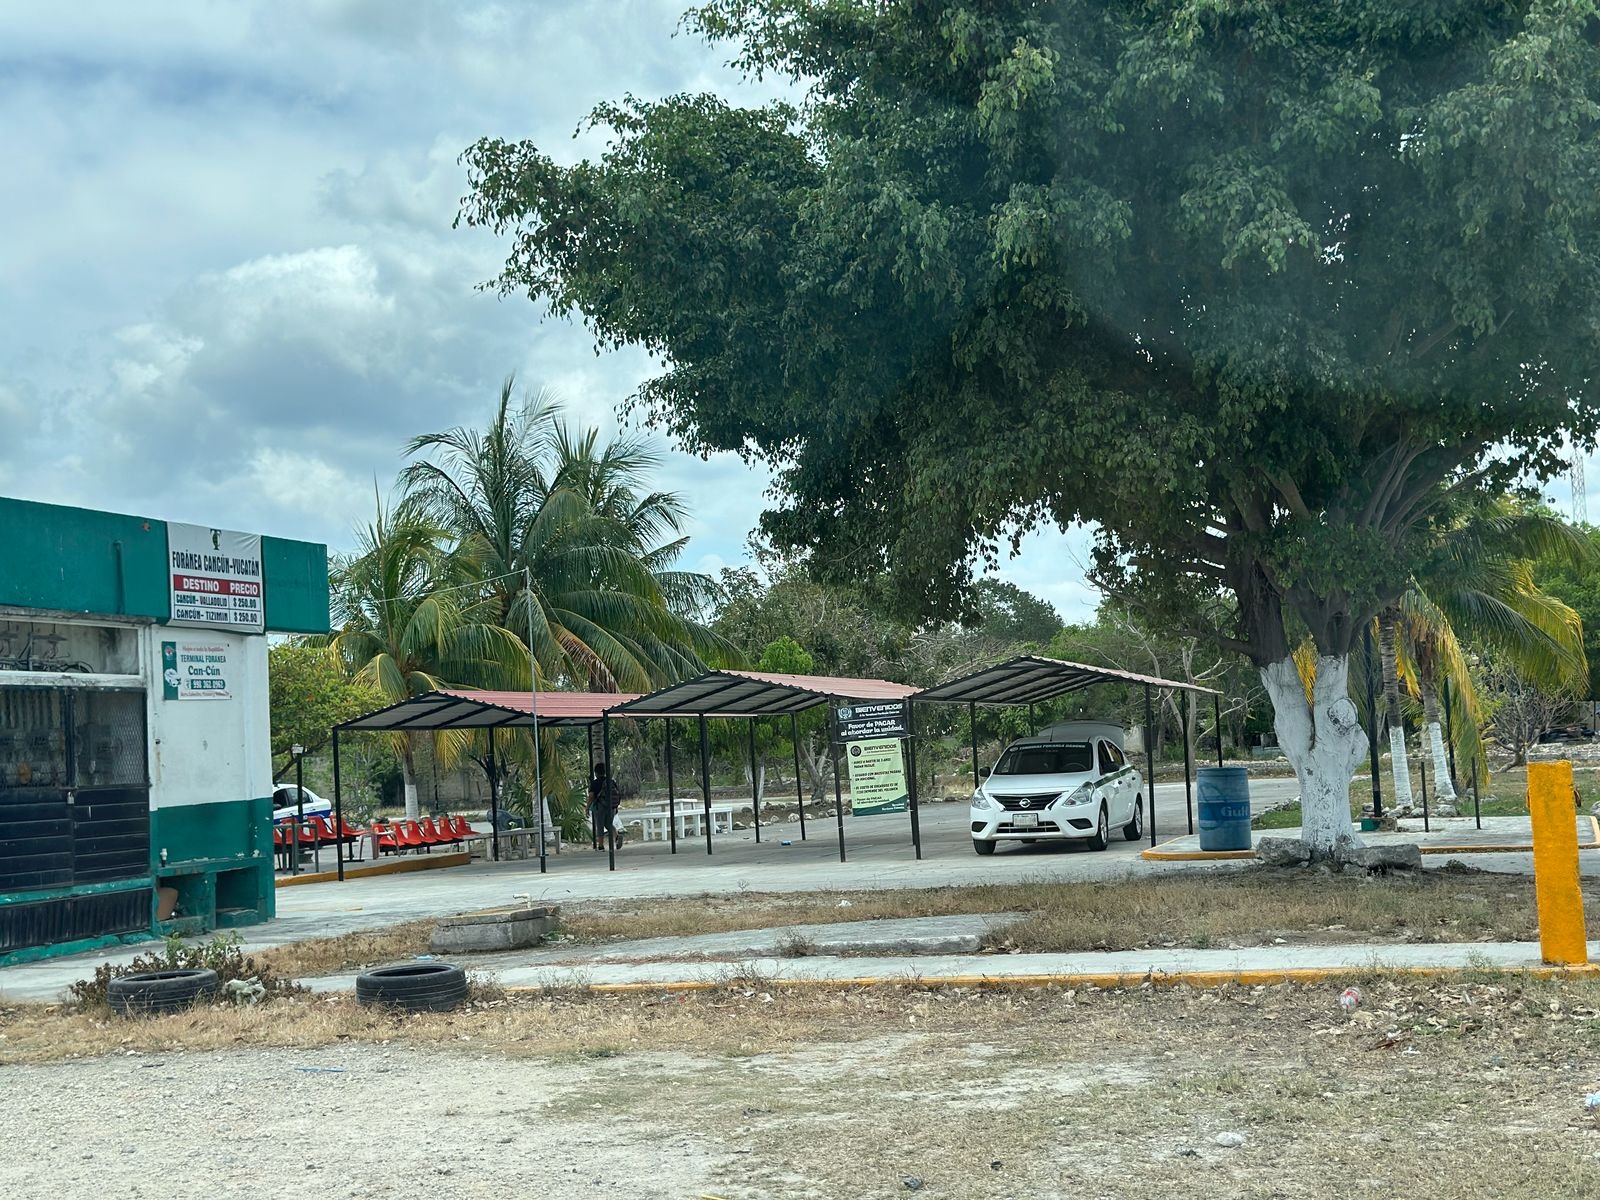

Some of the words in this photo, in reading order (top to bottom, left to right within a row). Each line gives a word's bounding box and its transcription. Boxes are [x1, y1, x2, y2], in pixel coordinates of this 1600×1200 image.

[173, 549, 202, 570] FORÁNEA
[204, 554, 259, 576] CANCÚN-YUCATÁN
[183, 578, 219, 591] DESTINO
[230, 583, 258, 595] PRECIO
[238, 598, 256, 608] 250.00
[238, 613, 257, 623] 250.00
[188, 665, 220, 675] Can-Cún
[855, 703, 903, 713] BIENVENIDOS
